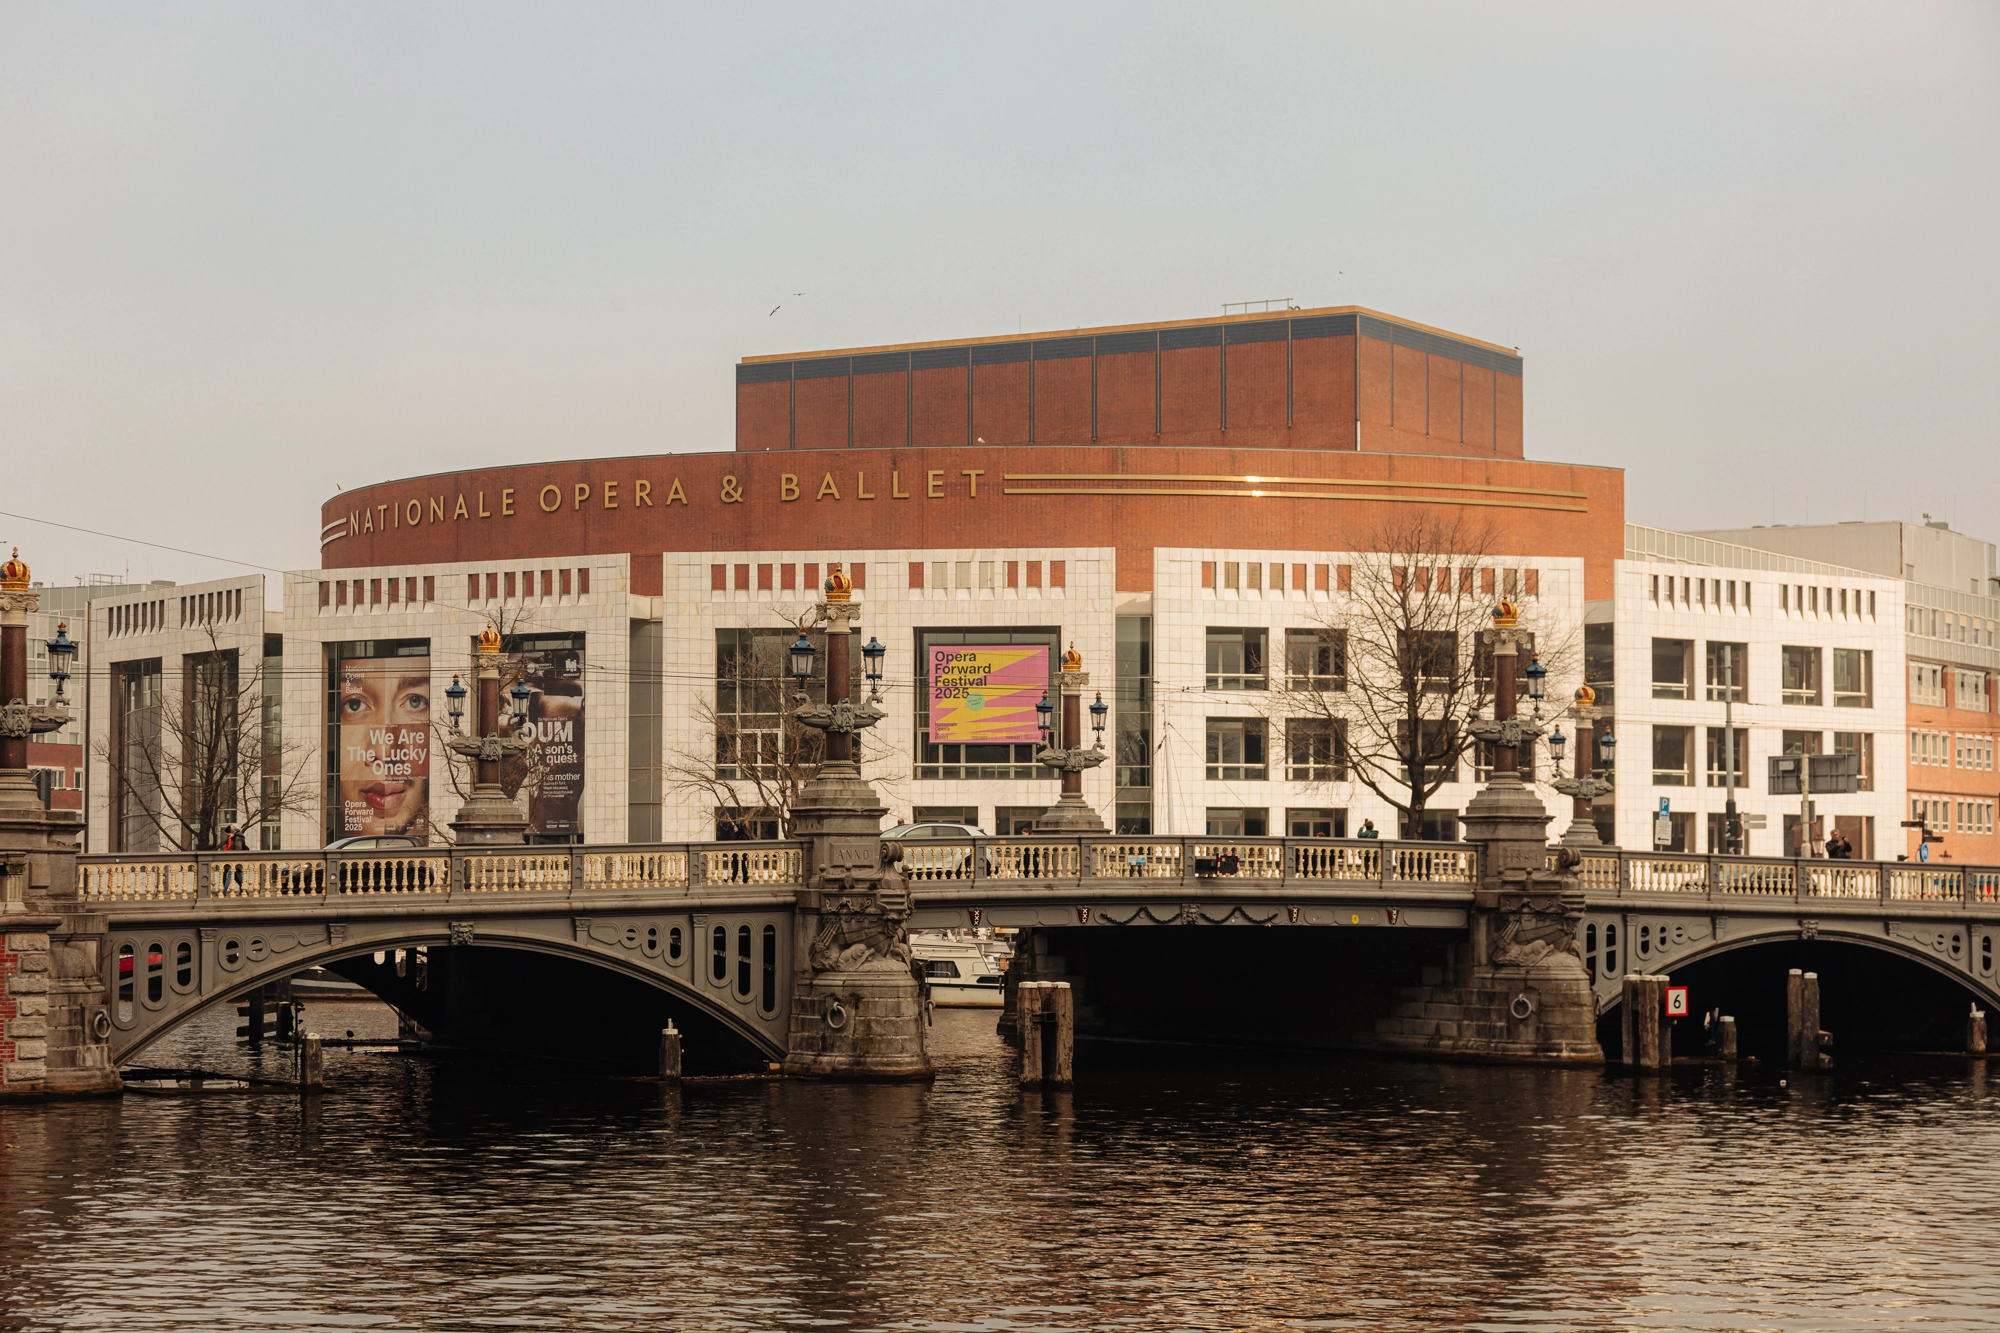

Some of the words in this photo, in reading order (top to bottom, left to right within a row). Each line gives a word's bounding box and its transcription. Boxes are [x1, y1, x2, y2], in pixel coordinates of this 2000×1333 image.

[350, 488, 515, 537] NATIONALE
[539, 478, 688, 512] OPERA
[720, 475, 744, 503] &
[780, 469, 985, 501] BALLET
[935, 651, 977, 664] Opera
[935, 663, 992, 674] Forward
[935, 675, 987, 686] Festival
[345, 686, 363, 694] Ballet
[935, 687, 970, 699] 2025
[369, 729, 394, 745] We
[398, 728, 425, 745] Are
[520, 721, 573, 743] OUM
[347, 746, 376, 762] The
[382, 745, 427, 764] Lucky
[545, 743, 573, 754] son's
[546, 752, 578, 766] quest
[372, 760, 412, 776] Ones
[555, 772, 581, 781] mother
[344, 800, 367, 809] Opera
[1662, 798, 1669, 810] P
[344, 808, 374, 816] Forward
[344, 823, 363, 831] 2025
[839, 849, 870, 860] ANNO
[1673, 993, 1681, 1009] 6
